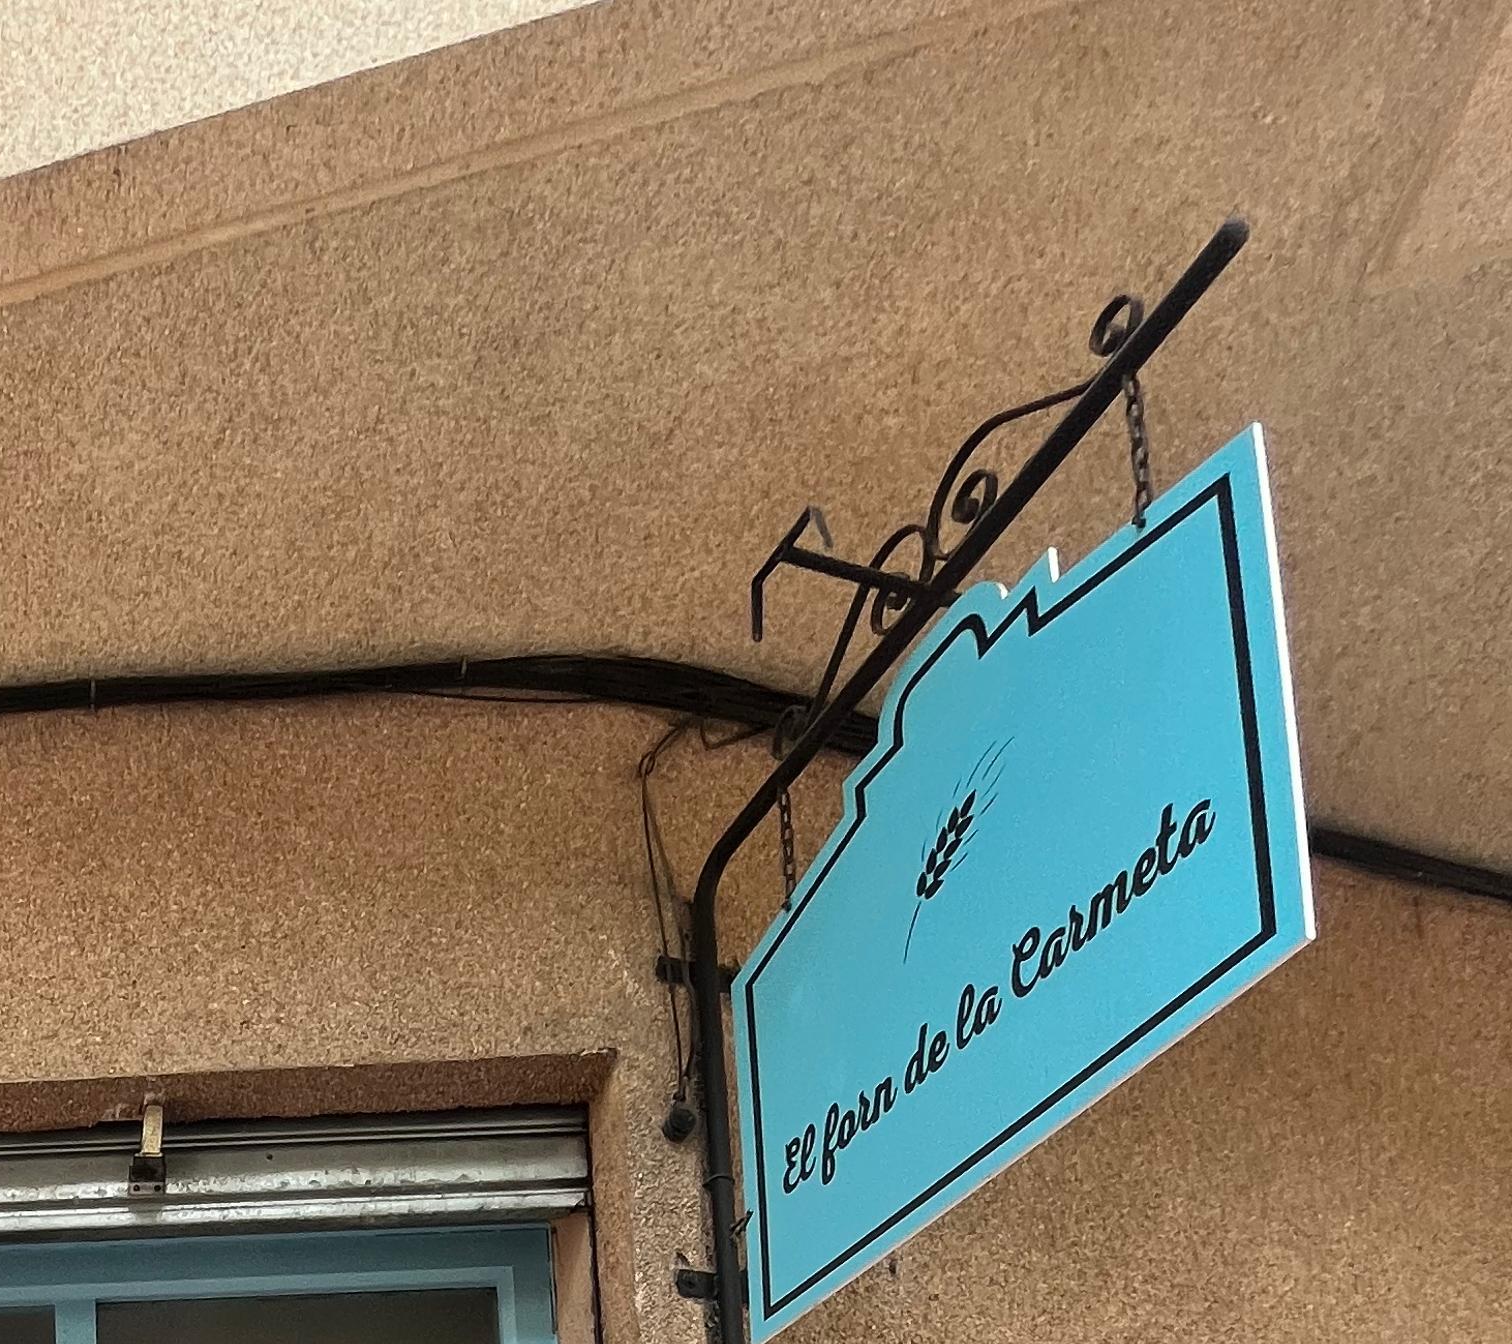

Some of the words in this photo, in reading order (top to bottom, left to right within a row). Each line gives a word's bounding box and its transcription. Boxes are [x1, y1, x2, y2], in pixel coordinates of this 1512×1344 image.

[783, 1124, 816, 1194] El
[821, 1075, 899, 1187] forn
[904, 1022, 952, 1095] de
[955, 983, 1004, 1051] la
[1010, 797, 1217, 999] Carmeta
